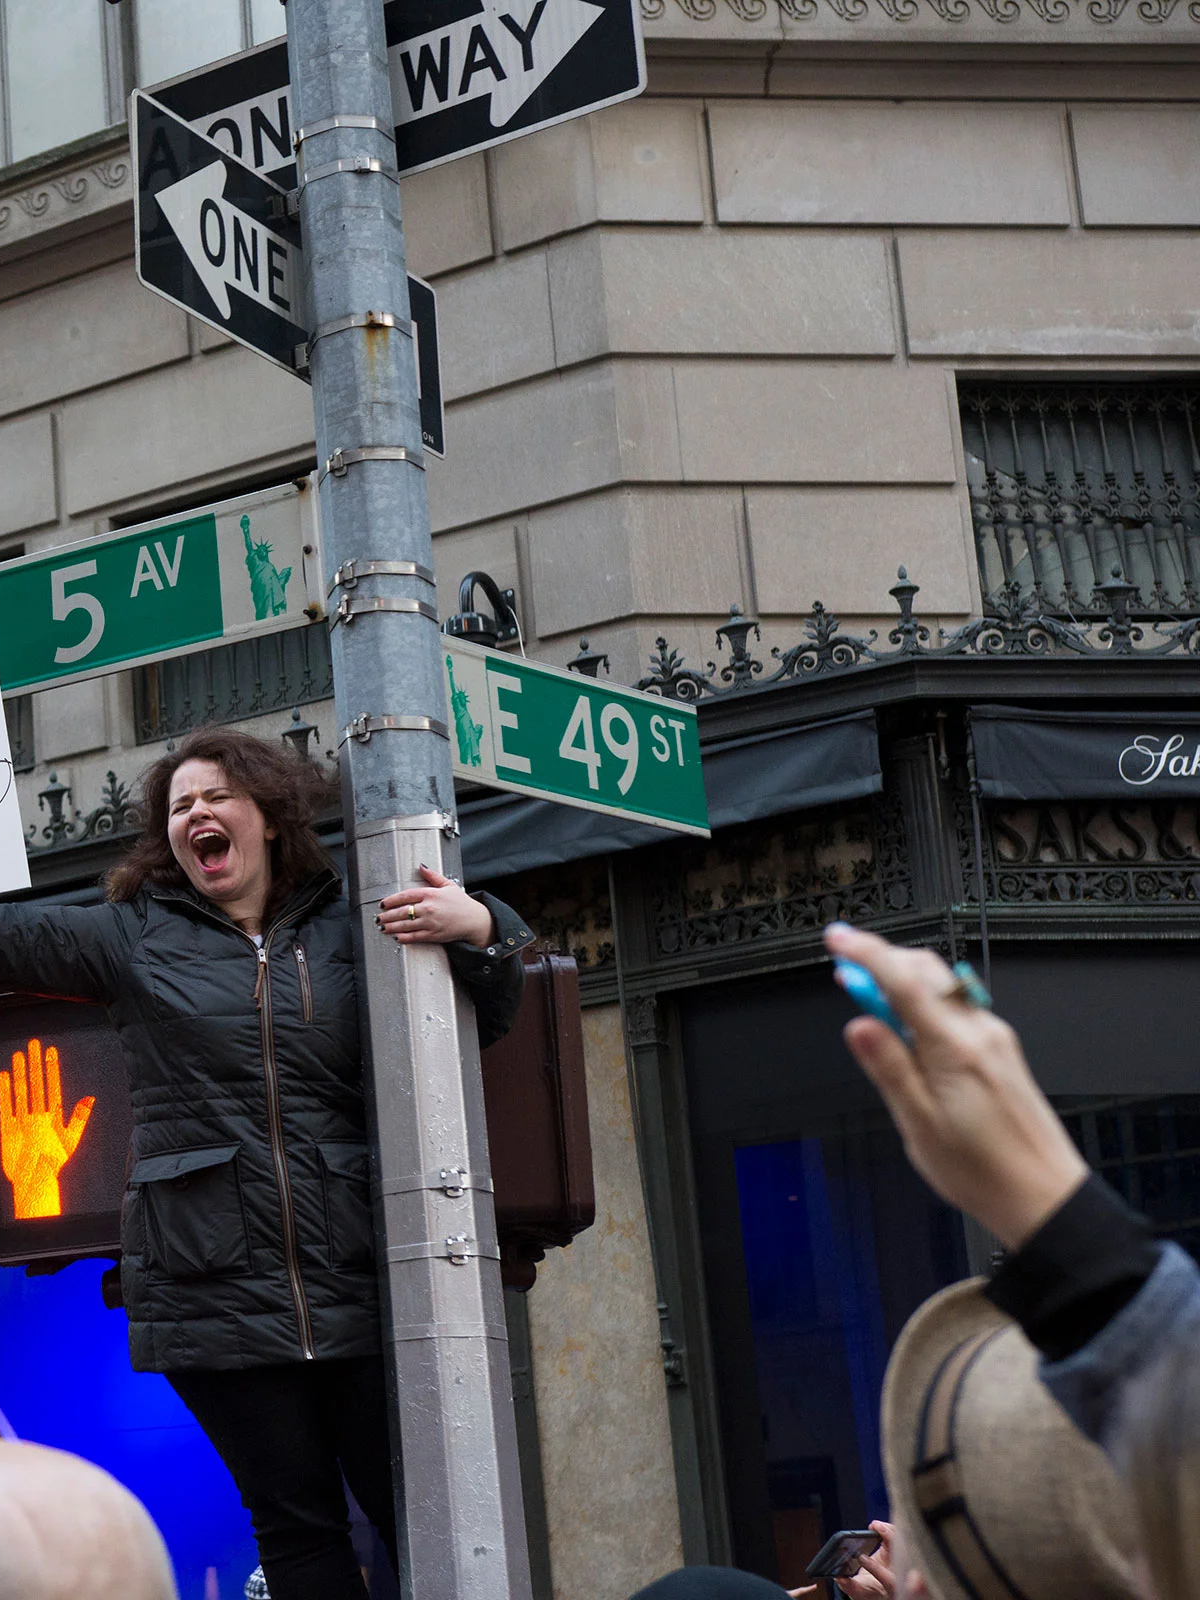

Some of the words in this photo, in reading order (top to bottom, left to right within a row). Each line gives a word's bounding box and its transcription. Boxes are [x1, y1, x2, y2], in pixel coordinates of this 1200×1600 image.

[400, 0, 548, 113] WAY
[200, 198, 291, 313] ONE
[50, 559, 105, 664] 5
[130, 535, 185, 598] AV
[494, 675, 533, 775] E
[559, 695, 639, 796] 49
[650, 714, 686, 767] ST
